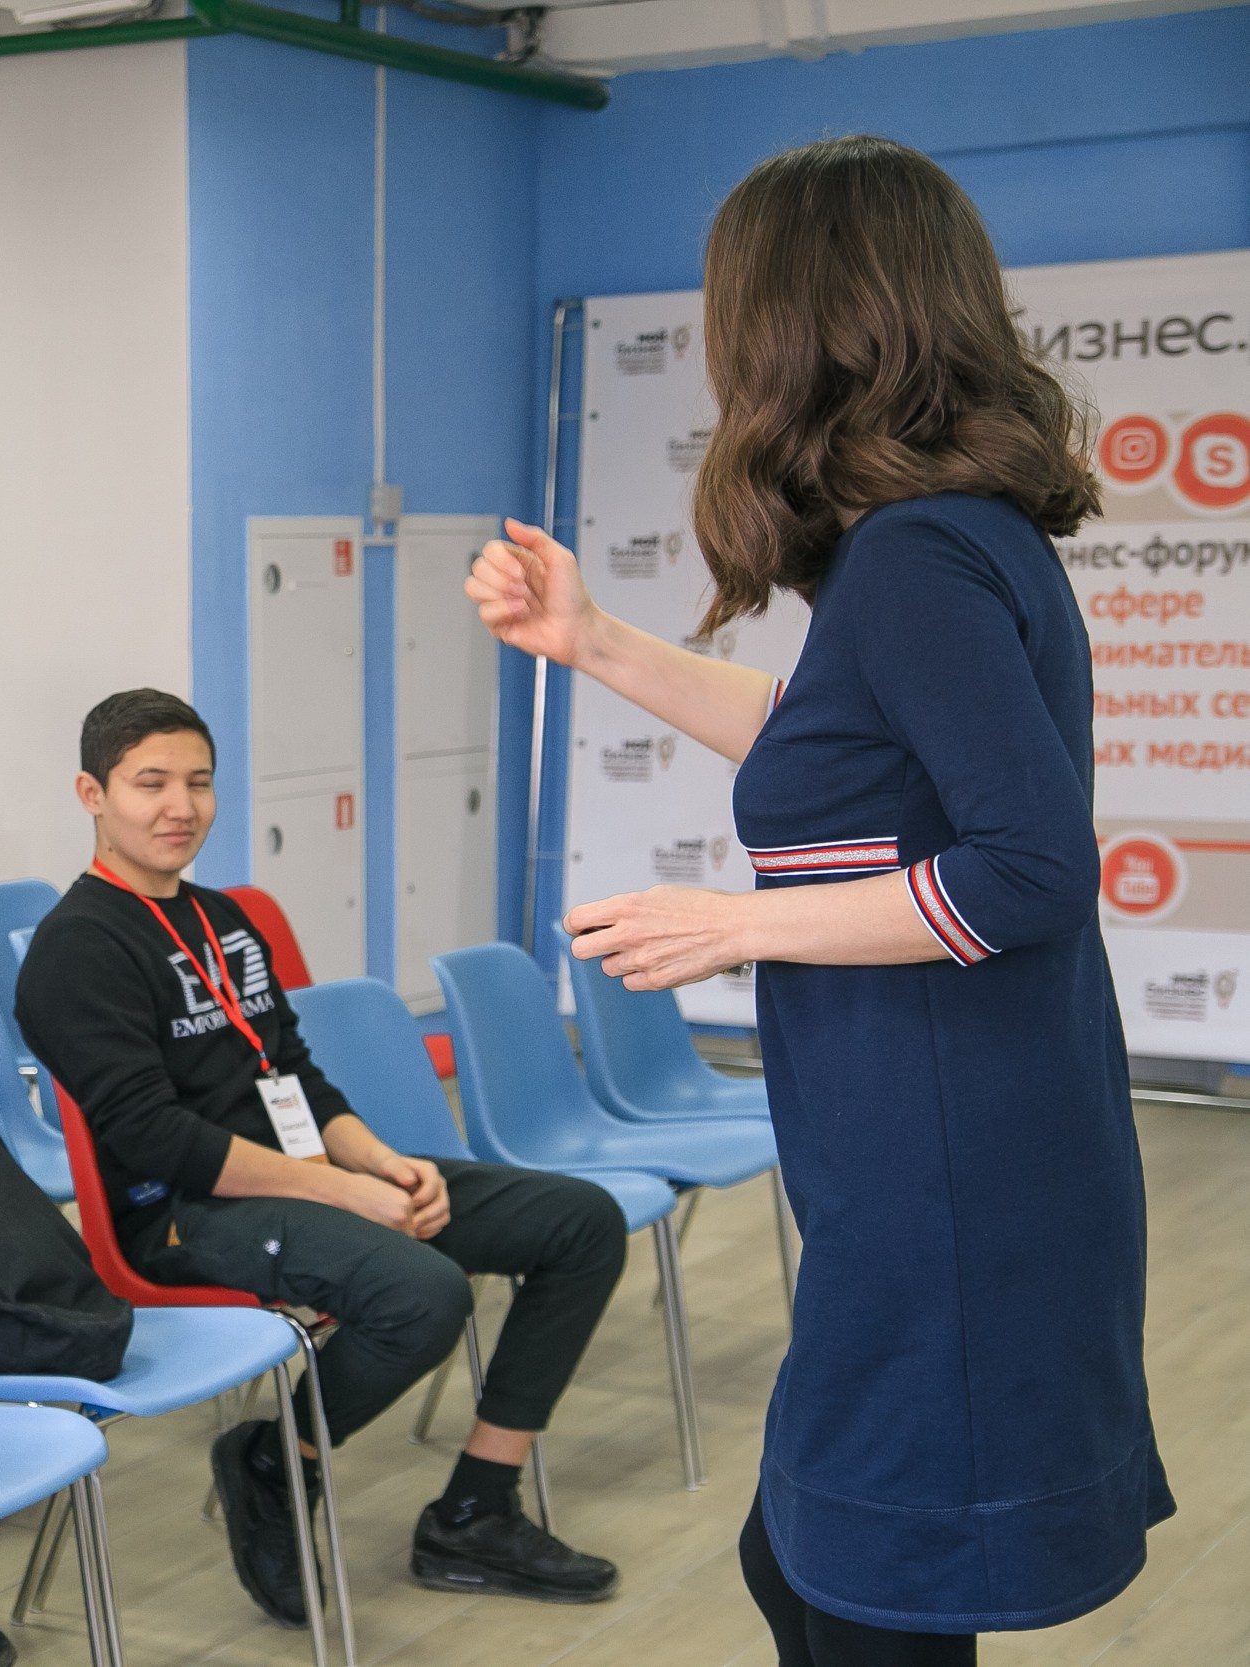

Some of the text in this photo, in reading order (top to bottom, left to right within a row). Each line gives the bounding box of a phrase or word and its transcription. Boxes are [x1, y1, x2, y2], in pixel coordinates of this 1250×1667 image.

[1009, 307, 1249, 362] изнес.
[1058, 533, 1250, 577] нес-фору
[1089, 584, 1205, 628] сфере
